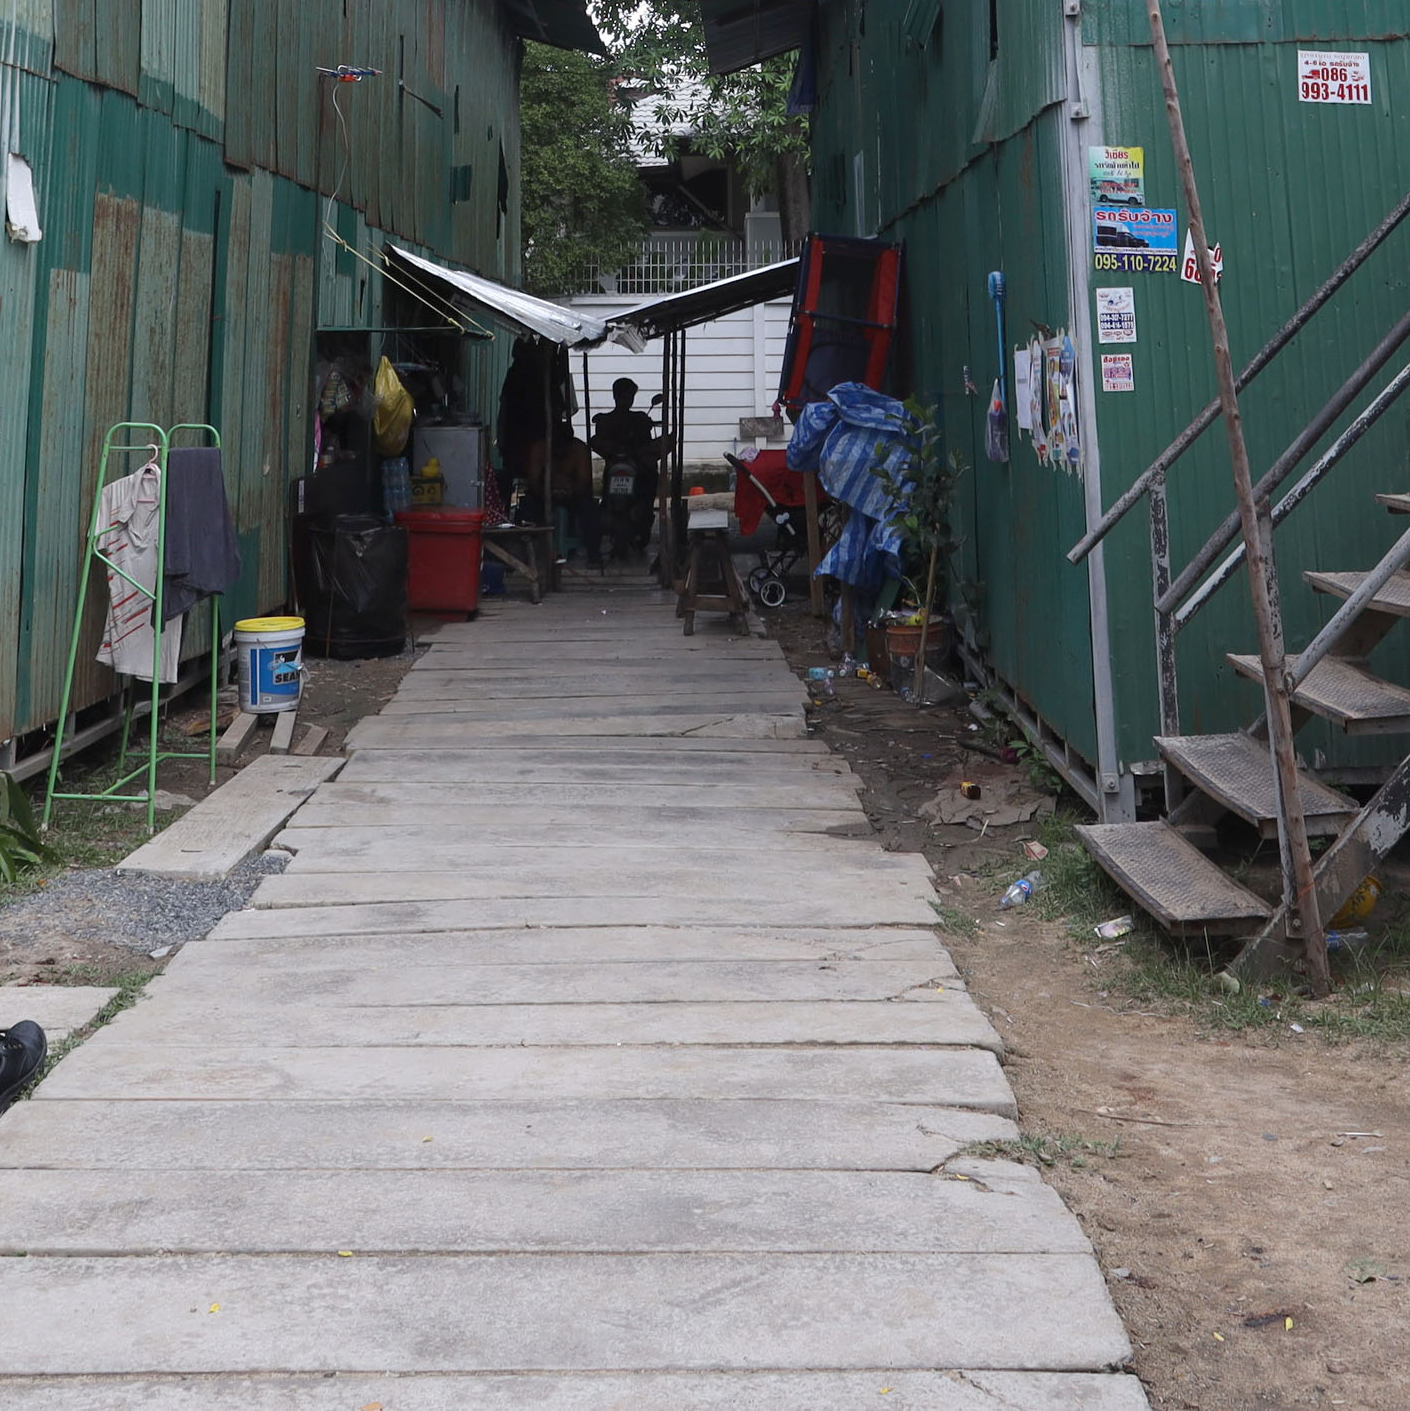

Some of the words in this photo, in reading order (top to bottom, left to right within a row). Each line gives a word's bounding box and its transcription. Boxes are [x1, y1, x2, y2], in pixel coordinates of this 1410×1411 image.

[1321, 67, 1348, 82] 086
[1301, 81, 1368, 101] 993-4111
[1095, 208, 1174, 223] รถรับจ้าง
[1094, 254, 1177, 272] 095-110-7224
